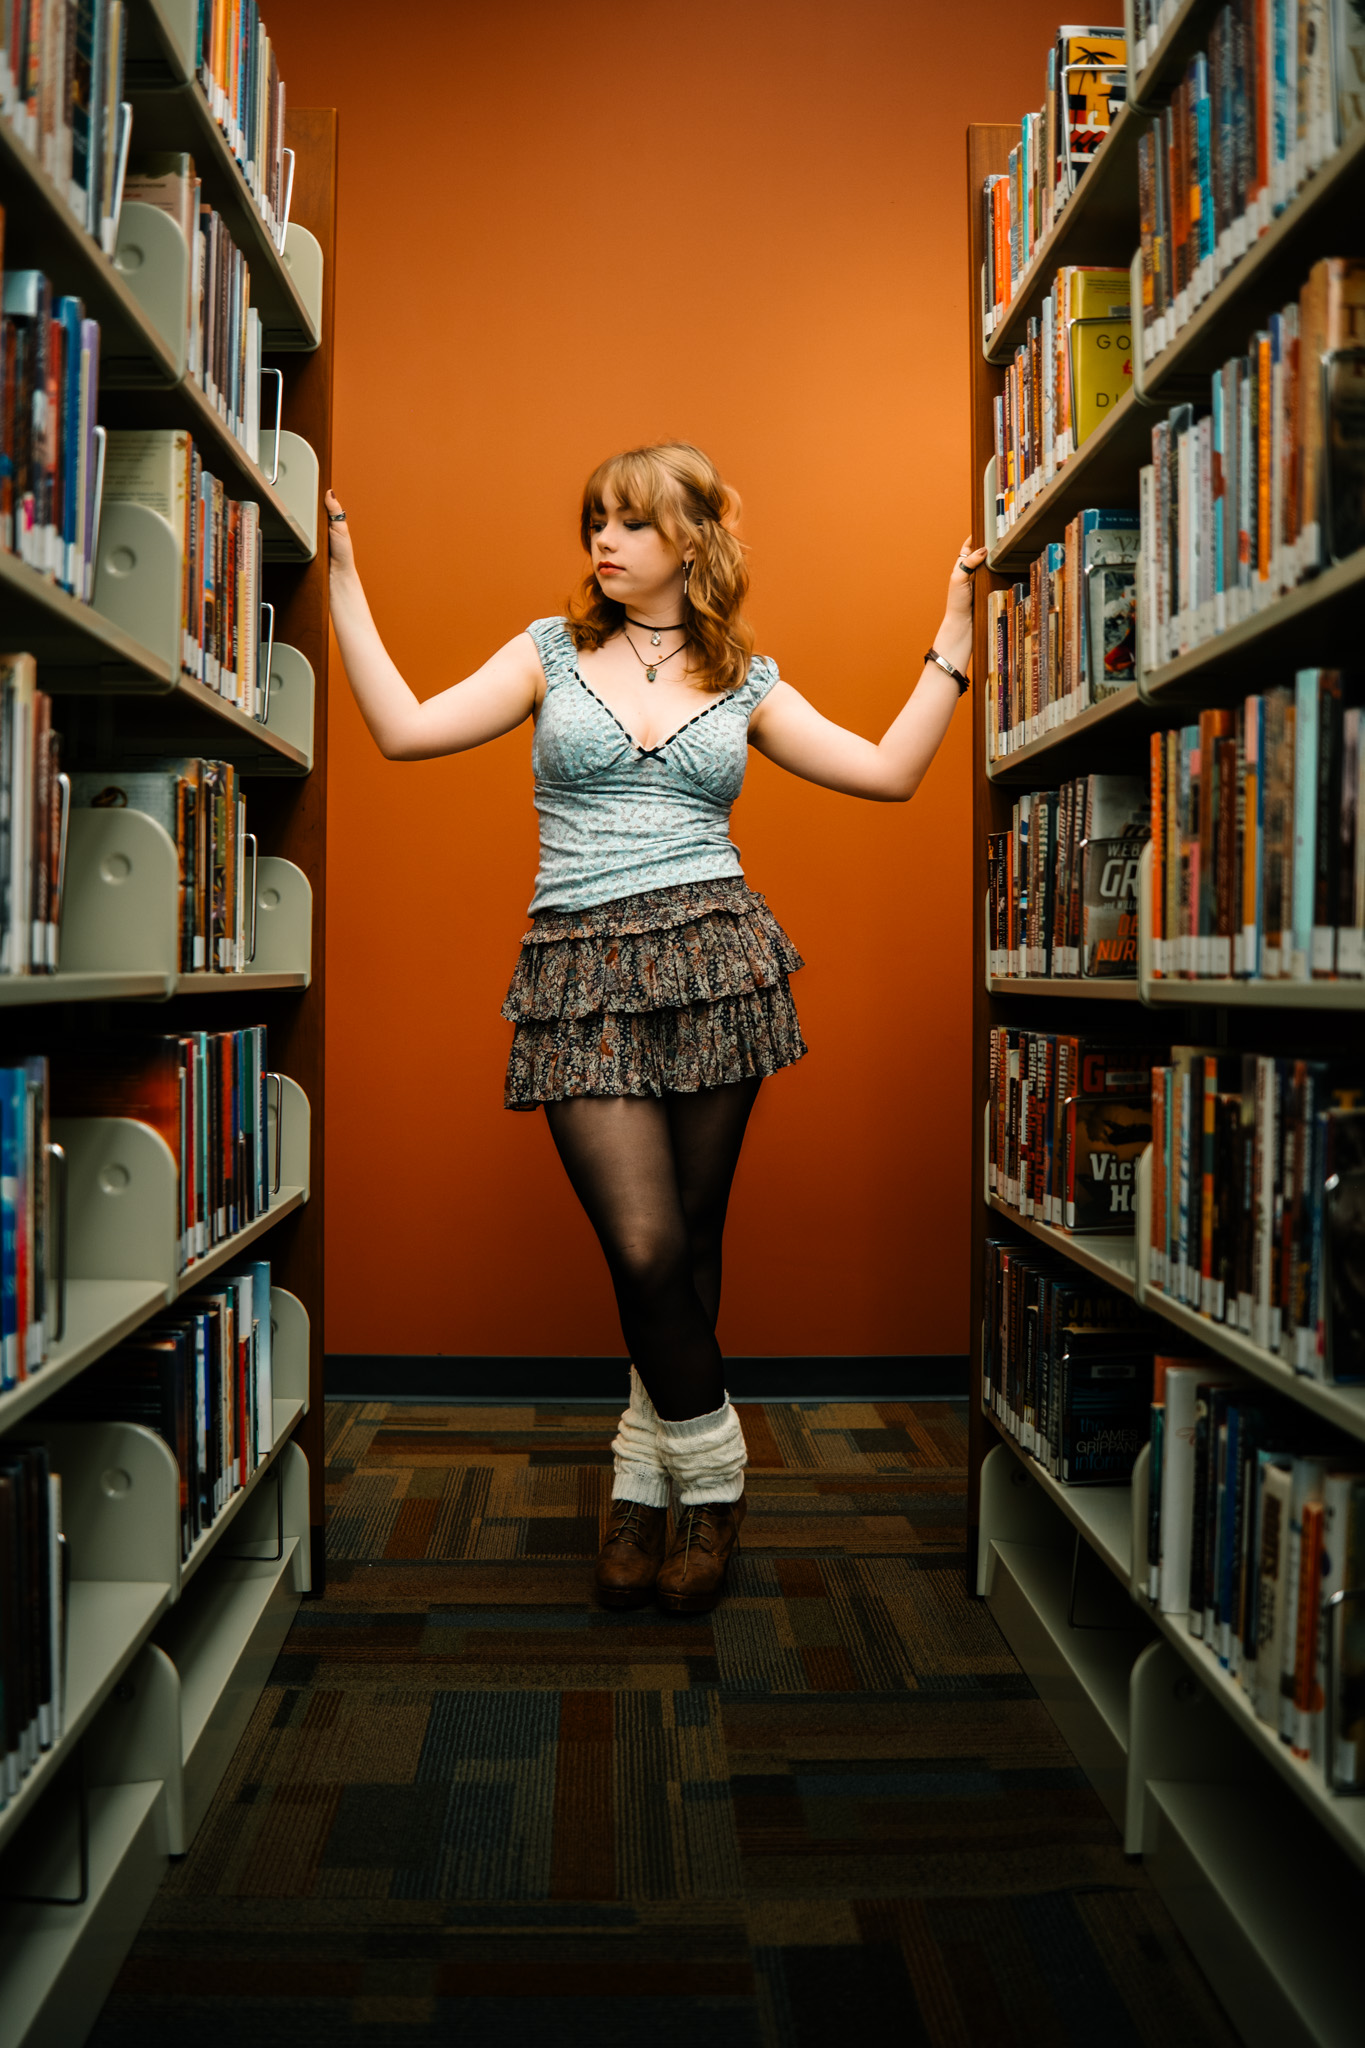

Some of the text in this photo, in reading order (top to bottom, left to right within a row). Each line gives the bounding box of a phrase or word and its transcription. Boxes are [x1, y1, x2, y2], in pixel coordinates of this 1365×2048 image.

[1038, 804, 1049, 872] Griffin
[989, 1029, 998, 1079] Griffin
[1037, 1040, 1048, 1099] Griffin
[1058, 1044, 1069, 1099] Griffin
[1093, 1429, 1139, 1441] JAMES
